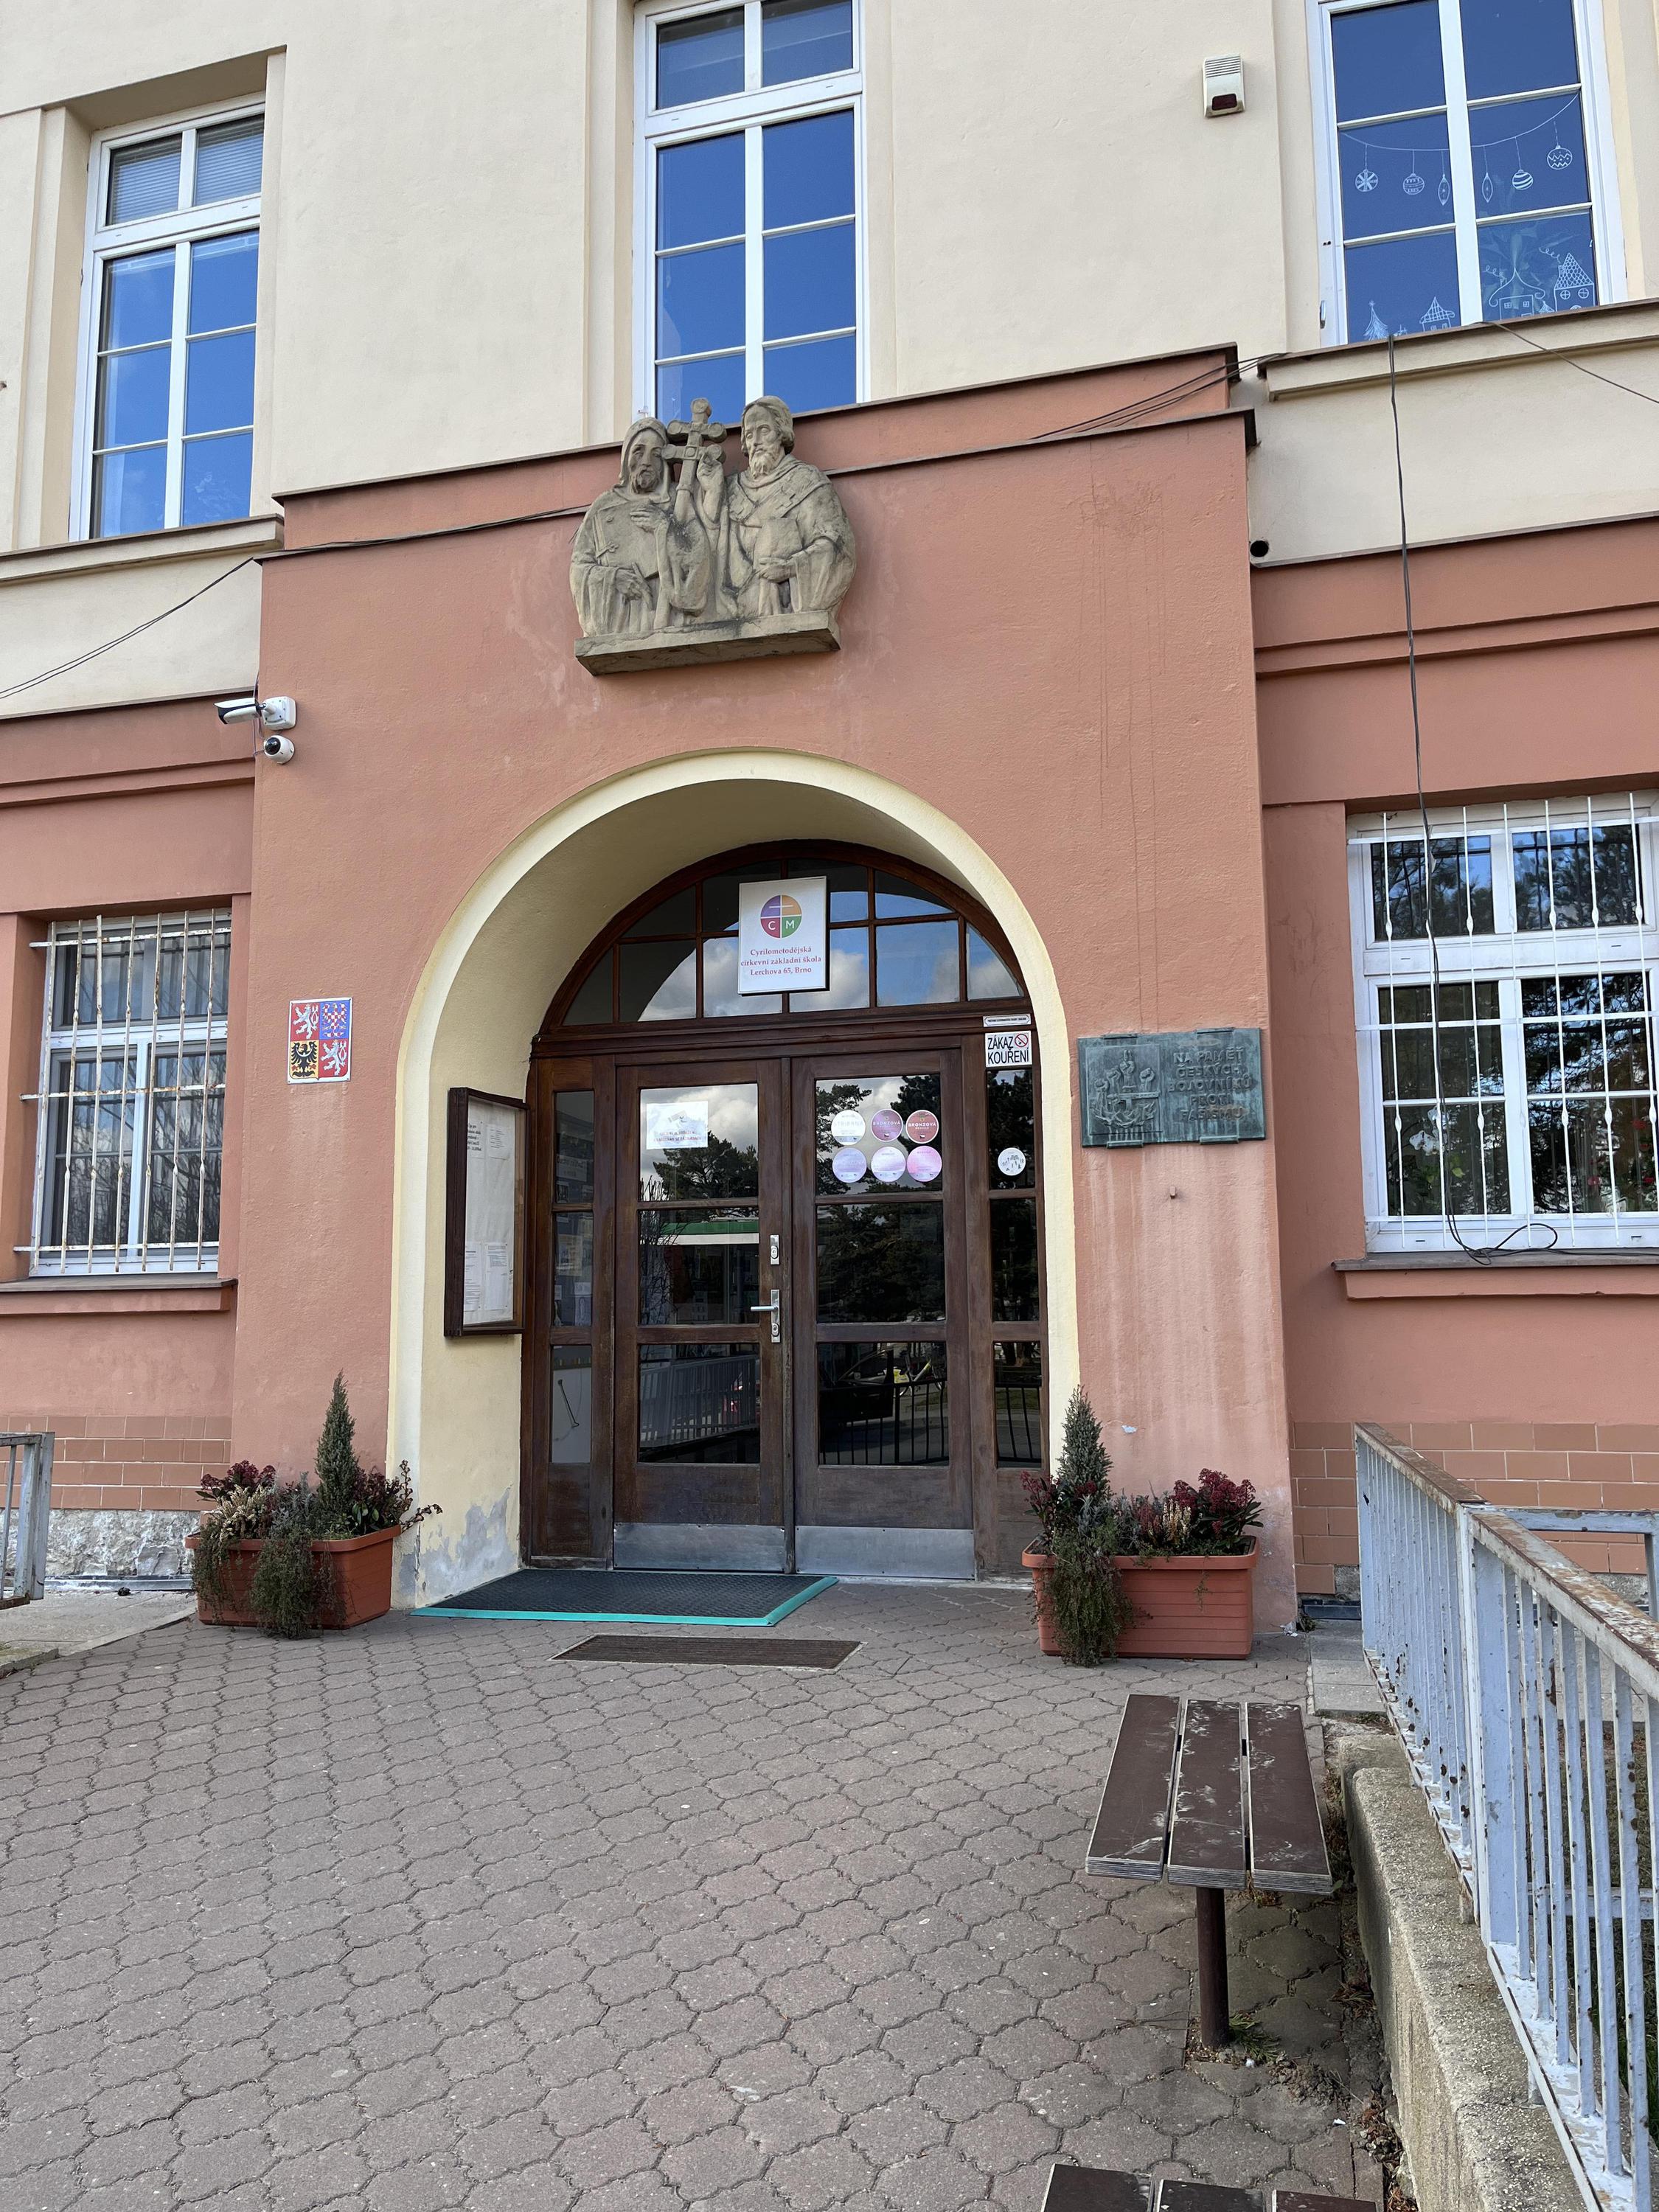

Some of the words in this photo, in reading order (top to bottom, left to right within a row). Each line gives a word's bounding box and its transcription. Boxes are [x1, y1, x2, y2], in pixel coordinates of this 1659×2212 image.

[768, 921, 776, 931] C
[786, 920, 795, 929] M
[750, 946, 812, 956] Cyrilometodějská
[750, 967, 782, 975] Lerchova
[988, 1035, 1013, 1050] ZÁKAZ
[988, 1047, 1029, 1064] KOUŘENÍ
[1173, 1051, 1192, 1063] NA
[1197, 1047, 1244, 1062] PAMĚŤ
[1175, 1062, 1242, 1077] ČESKÝCH
[1168, 1074, 1251, 1092] BOJOVNÍKŮ
[1189, 1093, 1234, 1107] PROTI
[1180, 1105, 1244, 1121] FAŠISMU
